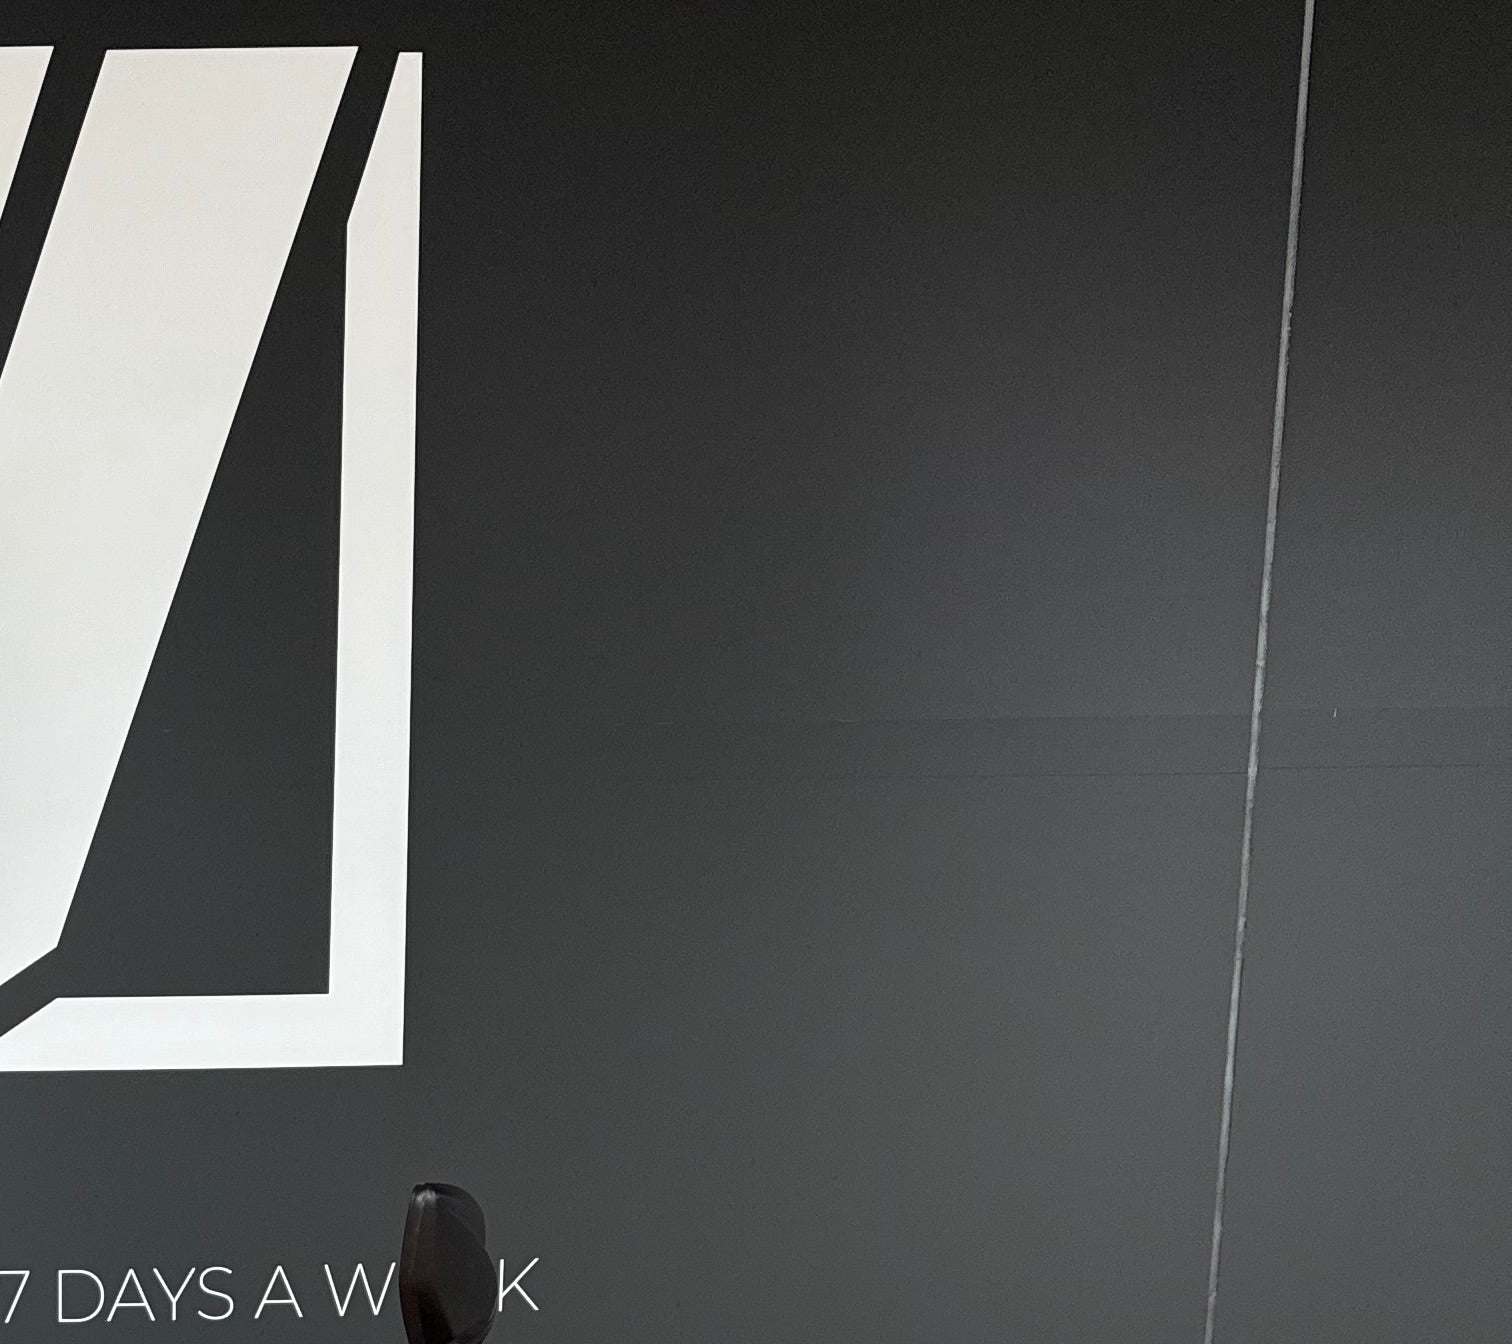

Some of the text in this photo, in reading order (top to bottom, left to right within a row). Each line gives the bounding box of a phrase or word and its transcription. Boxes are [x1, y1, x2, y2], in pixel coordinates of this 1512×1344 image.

[58, 1267, 233, 1322] DAYS
[255, 1266, 303, 1318] A
[325, 1257, 539, 1316] WK
